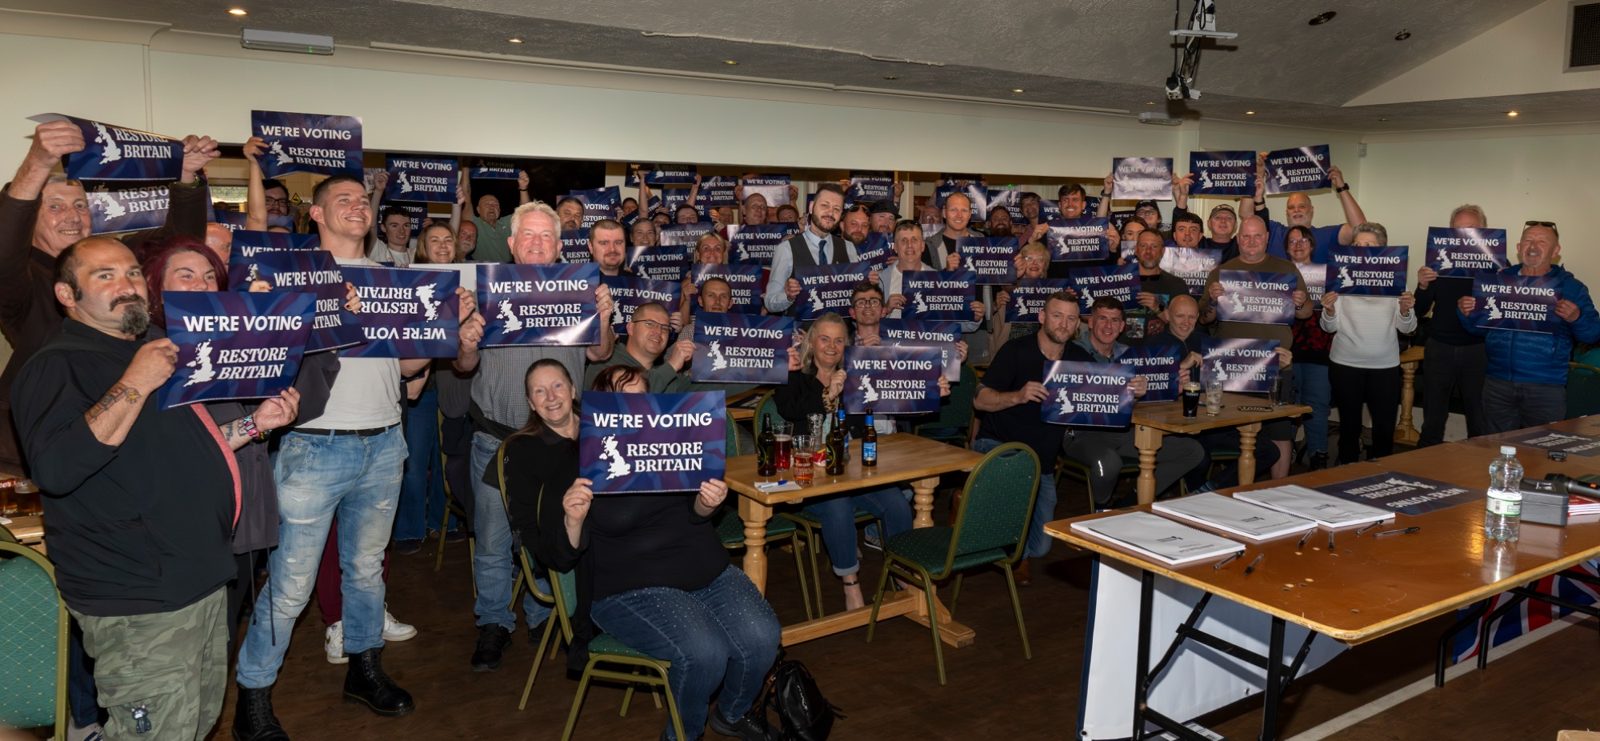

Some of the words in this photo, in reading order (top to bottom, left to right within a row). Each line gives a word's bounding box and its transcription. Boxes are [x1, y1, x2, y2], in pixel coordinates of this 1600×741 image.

[260, 125, 300, 137] WE'RE
[302, 127, 352, 140] VOTING
[123, 144, 172, 159] BRITAIN
[288, 146, 346, 159] RESTORE
[295, 156, 346, 168] BRITAIN
[393, 160, 419, 169] WE'RE
[421, 162, 453, 171] VOTING
[1196, 160, 1220, 168] WE'RE
[1221, 159, 1251, 167] VOTING
[1270, 157, 1293, 165] WE'RE
[1211, 173, 1247, 181] RESTORE
[1286, 167, 1321, 177] RESTORE
[410, 175, 448, 184] RESTORE
[1290, 173, 1321, 183] BRITAIN
[414, 184, 448, 193] BRITAIN
[1214, 180, 1247, 188] BRITAIN
[119, 185, 170, 200] RESTO
[584, 203, 610, 211] VOTING
[733, 232, 754, 240] WE'RE
[756, 232, 782, 240] VOTING
[1433, 237, 1460, 246] WE'RE
[1462, 238, 1499, 247] VOTING
[567, 251, 590, 259] RESTO
[857, 248, 885, 262] VOTING
[962, 246, 985, 254] WE'RE
[985, 246, 1013, 254] VOTING
[656, 253, 684, 261] VOTING
[1334, 255, 1362, 264] WE'RE
[1364, 256, 1401, 265] VOTING
[1451, 252, 1493, 261] RESTORE
[975, 259, 1008, 267] RESTORE
[1454, 260, 1493, 269] BRITAIN
[978, 267, 1008, 275] BRITAIN
[1352, 270, 1394, 279] RESTORE
[274, 272, 307, 287] WE'RE
[307, 269, 343, 285] VOTING
[651, 273, 680, 281] BRITAIN
[725, 274, 757, 283] VOTING
[803, 275, 829, 285] WE'RE
[830, 273, 864, 283] VOTING
[1075, 276, 1100, 285] WE'RE
[1101, 273, 1133, 282] VOTING
[1355, 278, 1394, 287] BRITAIN
[489, 281, 533, 294] WE'RE
[534, 279, 589, 293] VOTING
[909, 281, 934, 289] WE'RE
[935, 281, 969, 289] VOTING
[1226, 279, 1253, 290] WE'RE
[1254, 280, 1290, 291] VOTING
[1481, 284, 1512, 294] WE'RE
[1514, 286, 1555, 297] VOTING
[356, 286, 413, 300] BRITAIN
[610, 287, 634, 297] WE'RE
[635, 289, 673, 302] VOTING
[731, 289, 752, 297] TORE
[821, 289, 853, 299] RESTOR
[1093, 286, 1130, 297] RESTORE
[732, 297, 752, 305] TAIN
[825, 299, 851, 308] BRITA
[925, 295, 964, 303] RESTORE
[1026, 299, 1046, 307] REST
[1242, 295, 1284, 306] RESTORE
[315, 298, 340, 313] TORE
[360, 301, 418, 314] RESTOR
[519, 303, 582, 316] RESTORE
[929, 302, 963, 311] BRITAIN
[1246, 304, 1284, 314] BRITAIN
[1500, 301, 1548, 312] RESTORE
[312, 313, 342, 329] ITAIN
[1504, 310, 1547, 321] BRITAIN
[183, 315, 240, 333] WE'RE
[242, 315, 303, 332] VOTING
[525, 316, 582, 329] BRITAIN
[364, 327, 399, 340] VOTI
[402, 327, 446, 340] WE'RE
[703, 325, 738, 337] WE'RE
[740, 327, 783, 339] VOTING
[887, 329, 916, 340] WE'RE
[917, 331, 954, 342] VOTING
[216, 346, 288, 365] RESTORE
[724, 346, 775, 357] RESTORE
[1238, 349, 1272, 358] VOTING
[729, 358, 774, 369] BRITAIN
[853, 360, 888, 370] WE'RE
[889, 360, 933, 370] VOTING
[1145, 357, 1175, 366] VOTING
[216, 363, 285, 380] BRITAIN
[875, 379, 926, 390] RESTORE
[1051, 373, 1084, 384] WE'RE
[1085, 374, 1126, 386] VOTING
[880, 389, 926, 400] BRITAIN
[1072, 392, 1120, 404] RESTORE
[1076, 403, 1119, 415] BRITAIN
[593, 413, 643, 428] WE'RE
[645, 412, 713, 428] VOTING
[626, 441, 703, 457] RESTORE
[634, 457, 703, 473] BRITAIN
